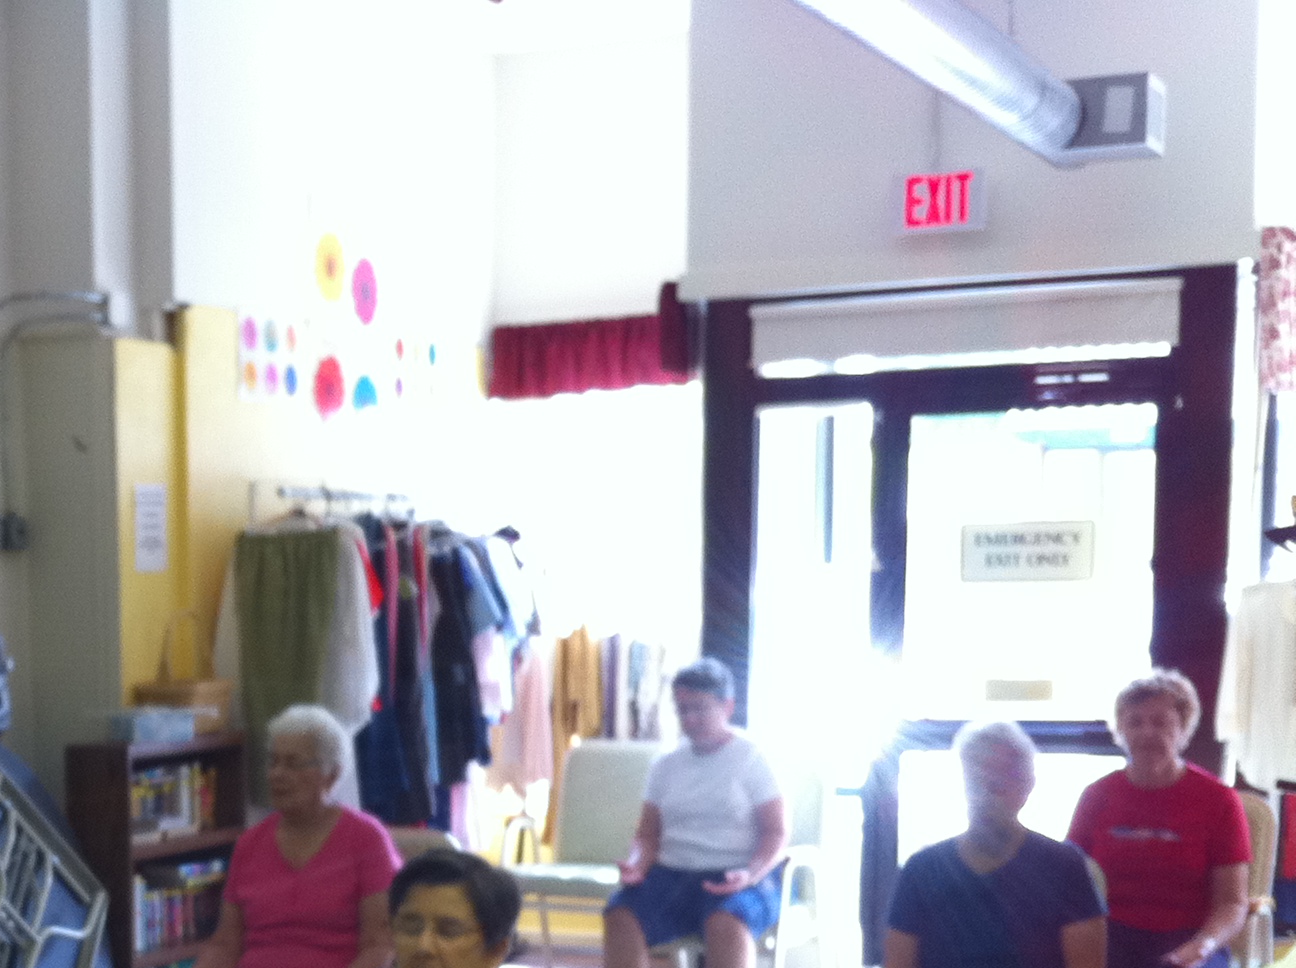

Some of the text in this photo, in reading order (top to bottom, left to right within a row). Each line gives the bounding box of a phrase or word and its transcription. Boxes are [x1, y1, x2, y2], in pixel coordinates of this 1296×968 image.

[904, 170, 975, 229] EXIT
[973, 530, 1081, 547] EMERGENCY
[984, 551, 1070, 568] EXIT ONLY
